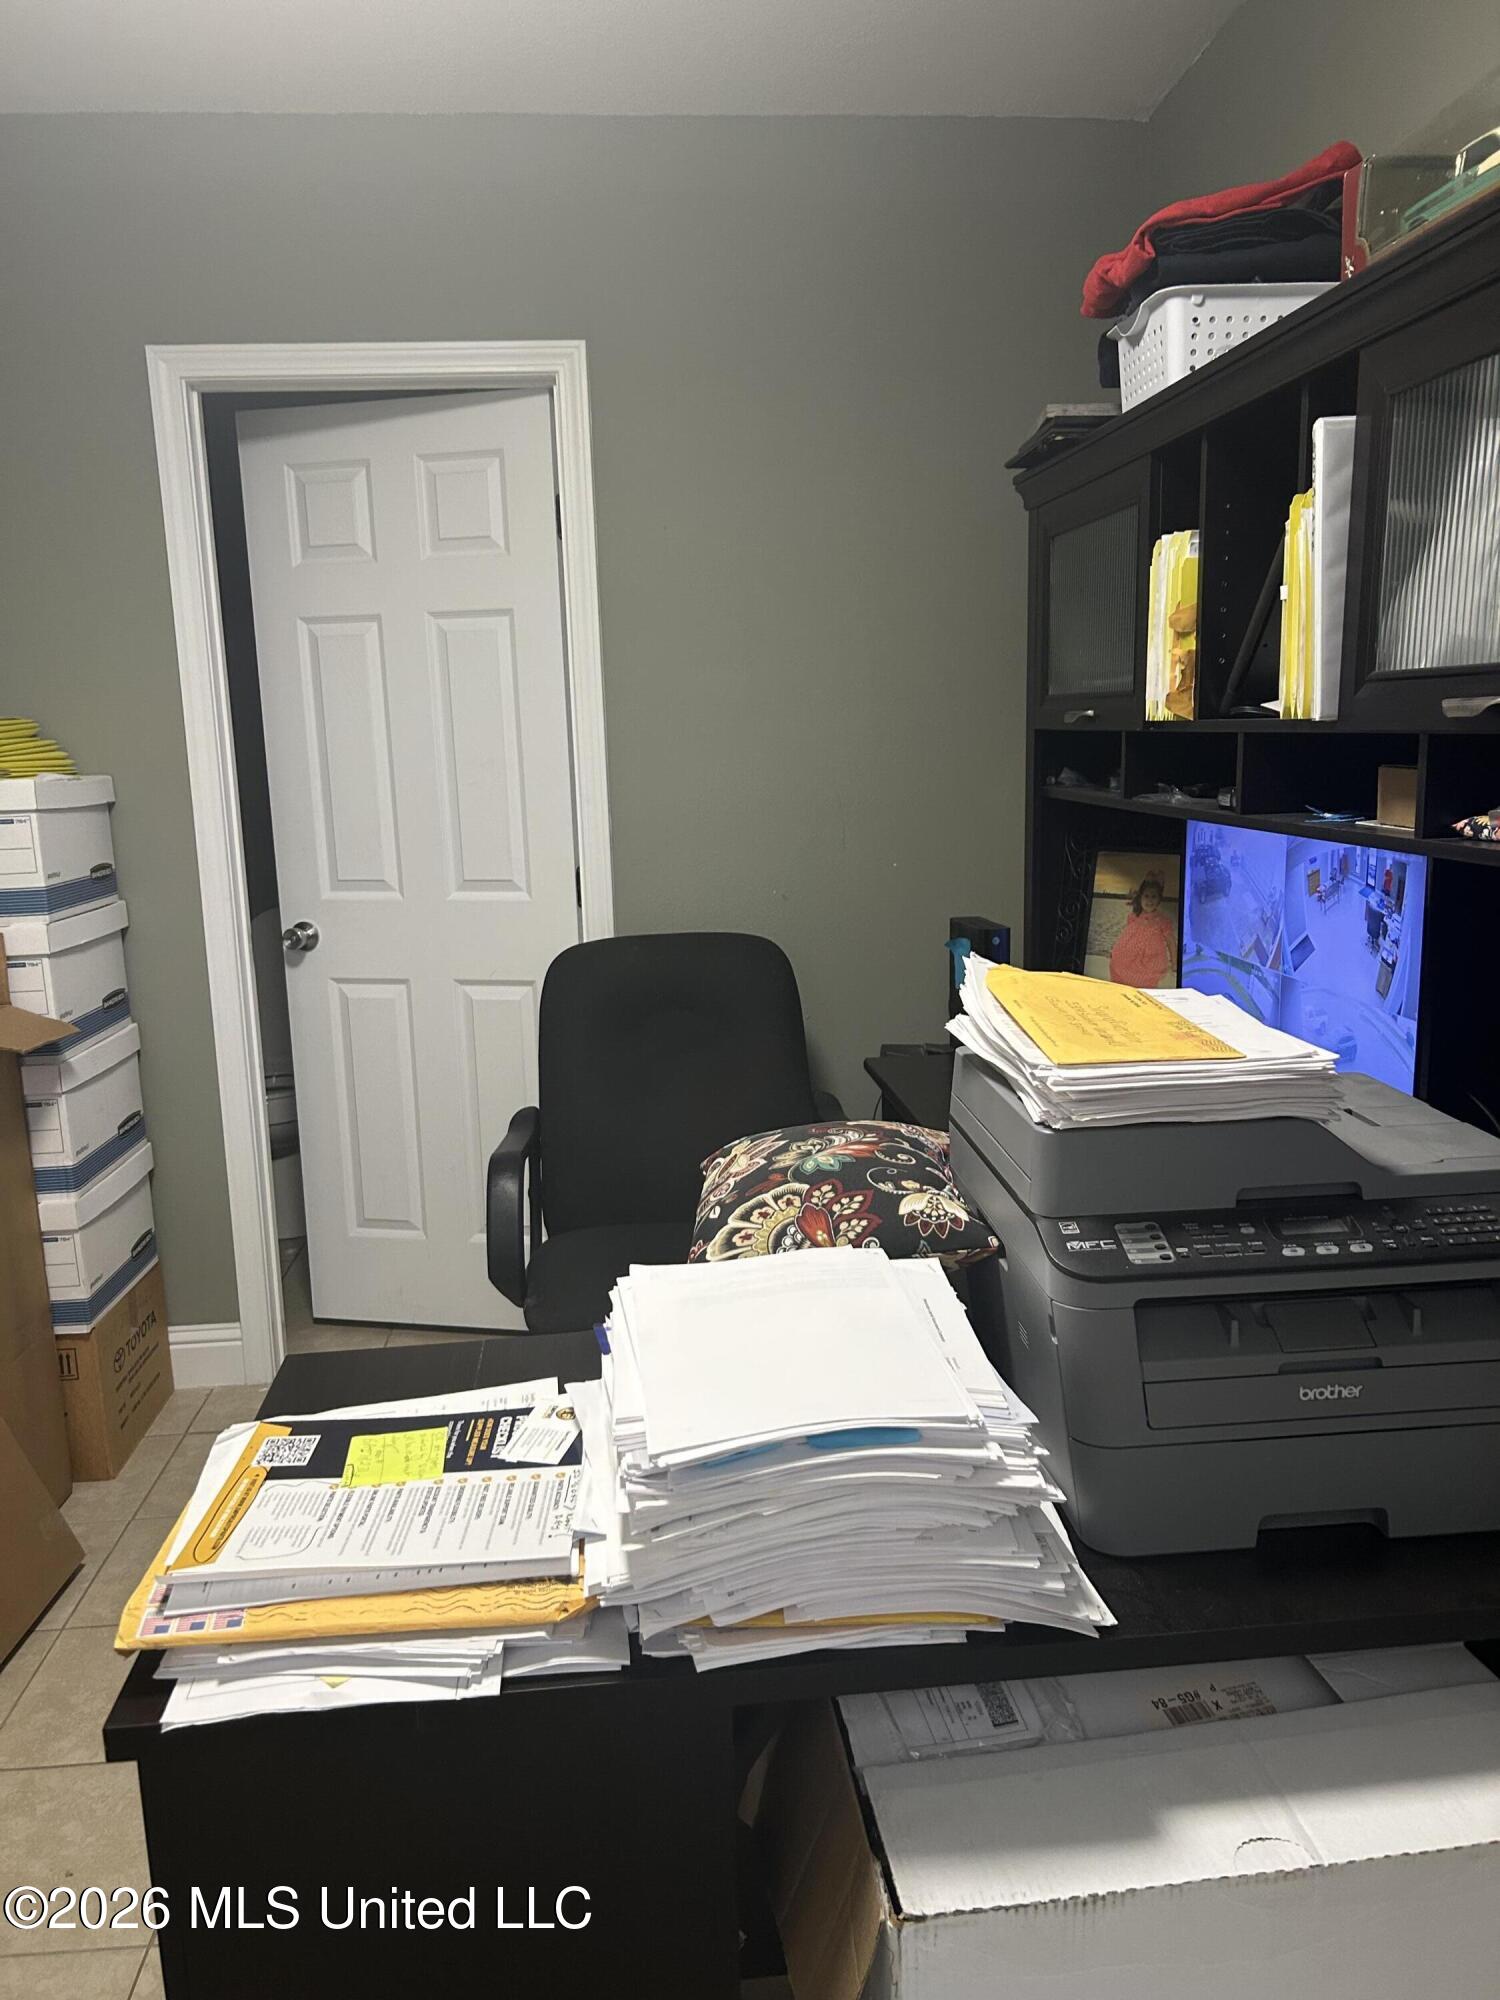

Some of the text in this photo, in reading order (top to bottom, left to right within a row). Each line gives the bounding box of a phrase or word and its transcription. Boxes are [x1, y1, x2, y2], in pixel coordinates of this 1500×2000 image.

[1065, 1239, 1118, 1252] MFC
[125, 1309, 157, 1356] TOYOTA
[1299, 1384, 1363, 1400] brother
